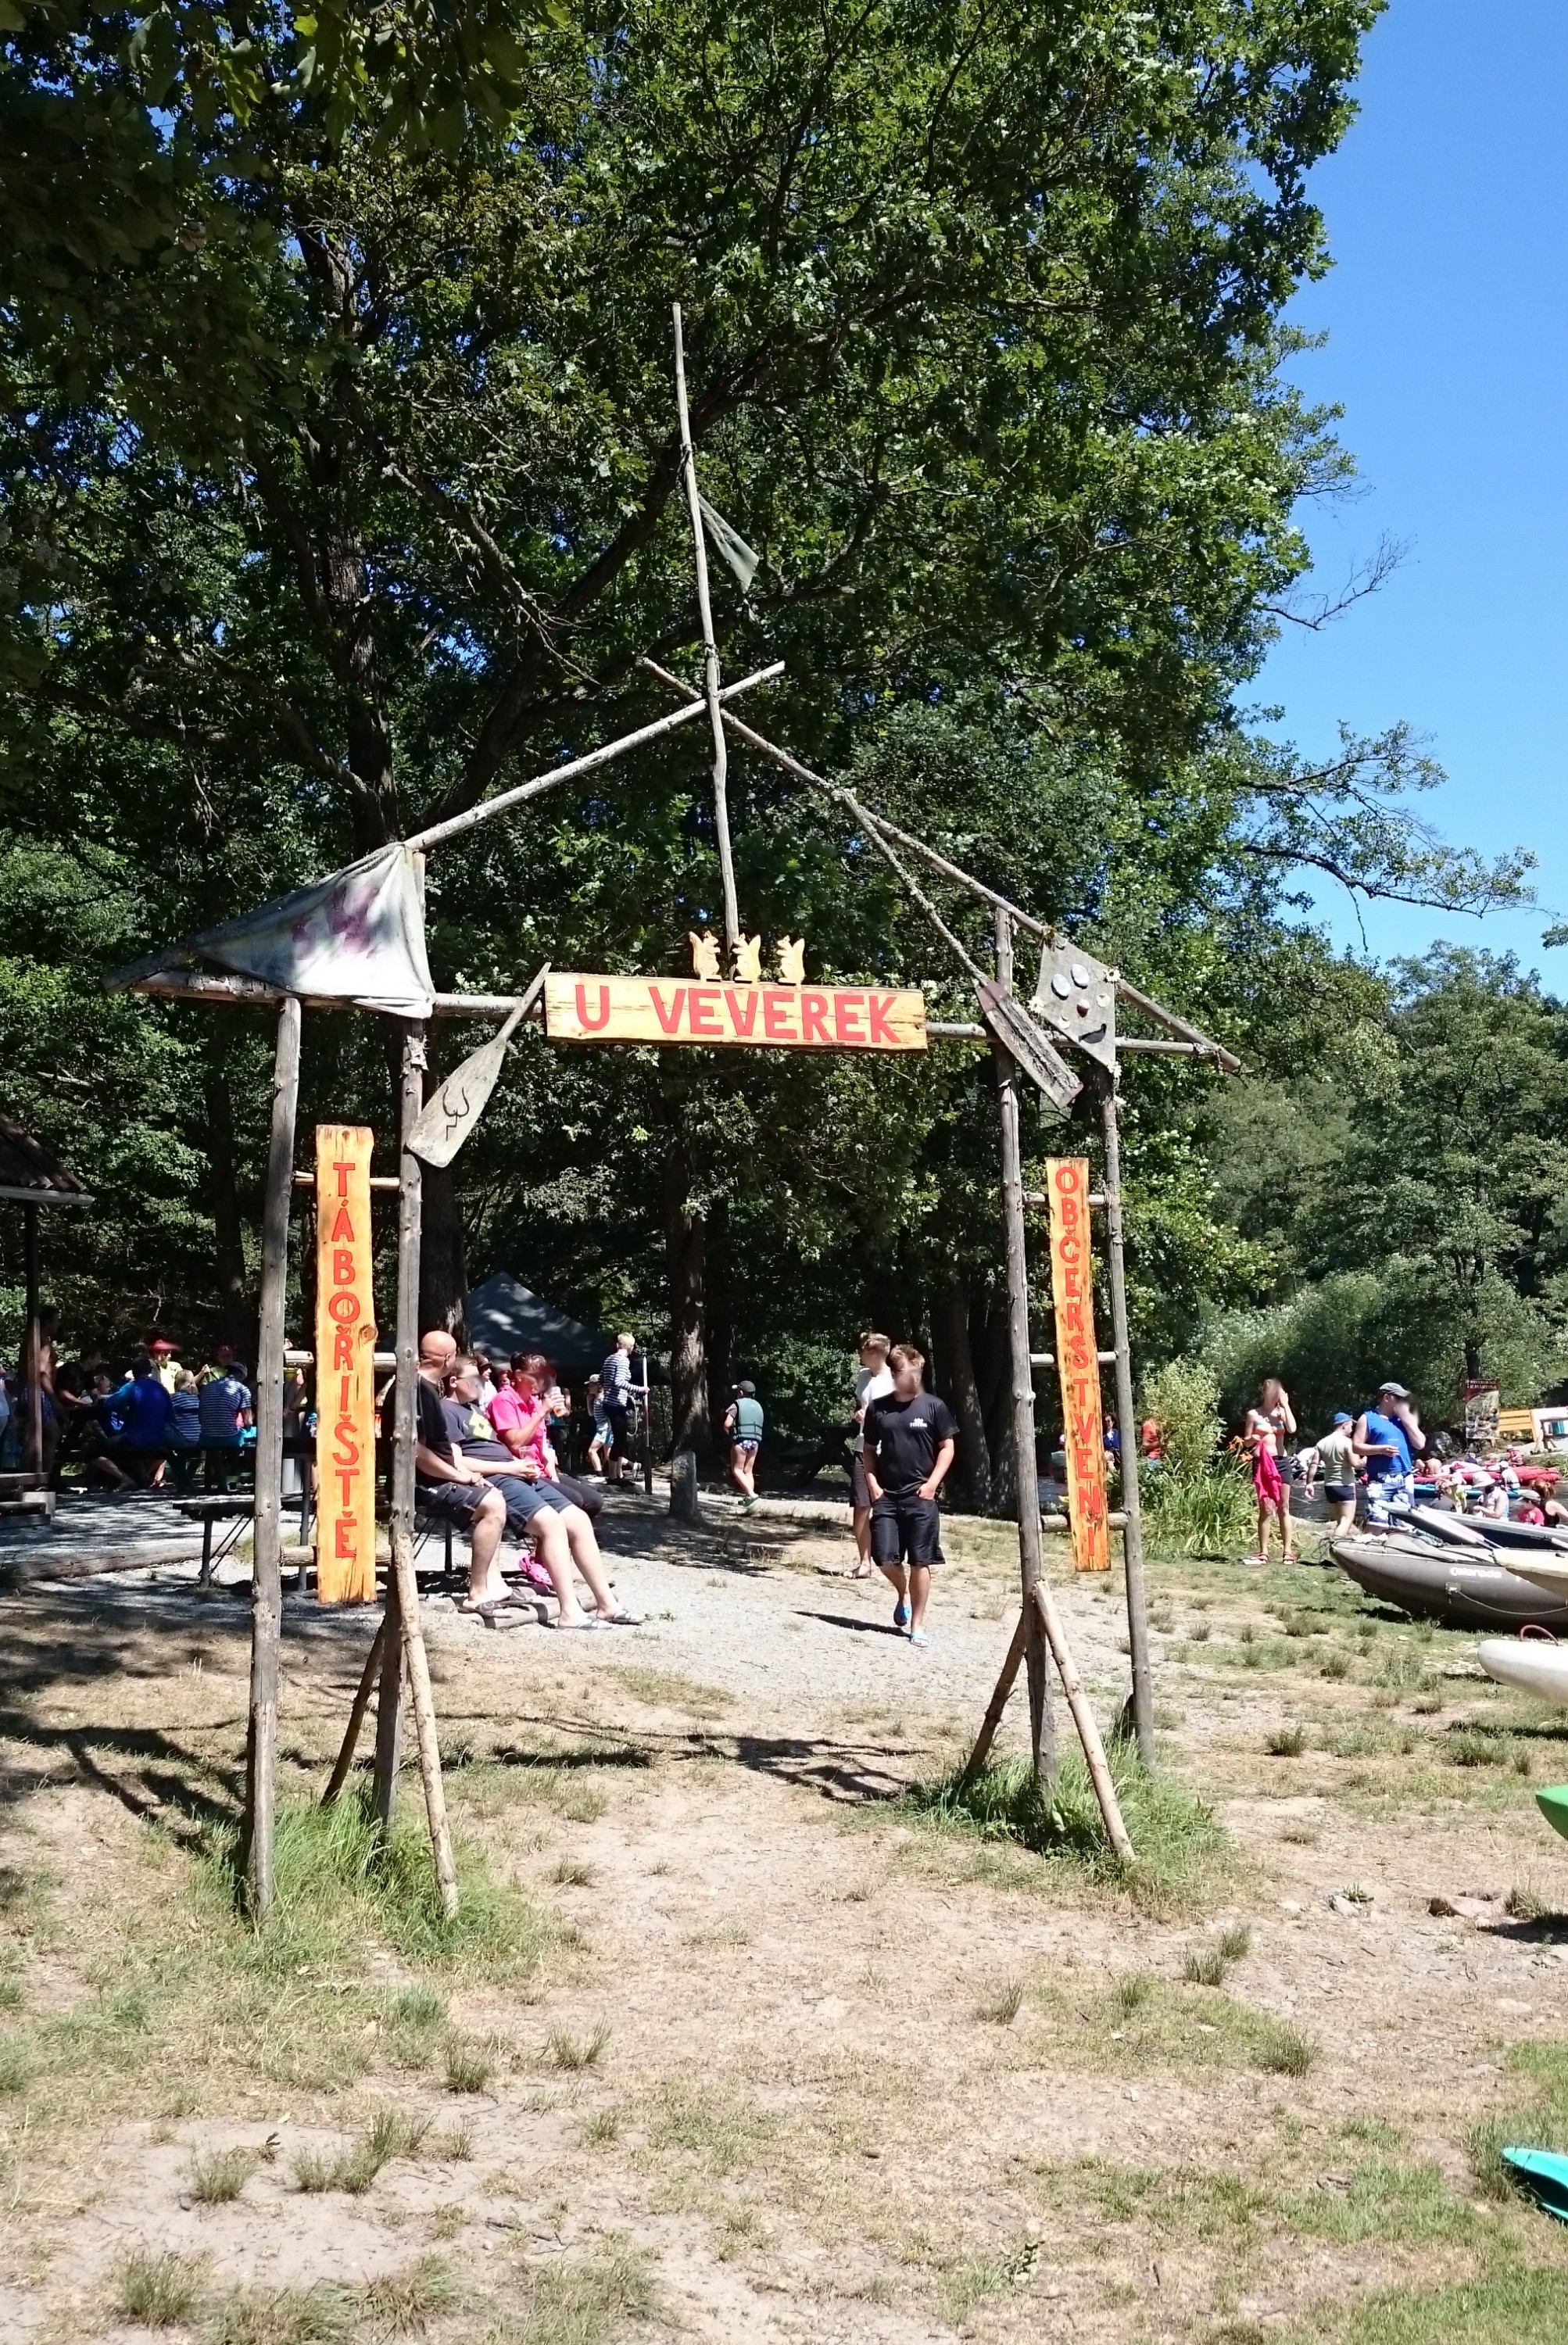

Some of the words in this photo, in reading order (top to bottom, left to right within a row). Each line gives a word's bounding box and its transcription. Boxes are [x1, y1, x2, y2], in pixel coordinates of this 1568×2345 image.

[575, 984, 610, 1031] U
[649, 986, 902, 1044] VEVEREK
[328, 1162, 360, 1559] TÁBOŘIŠTĚ
